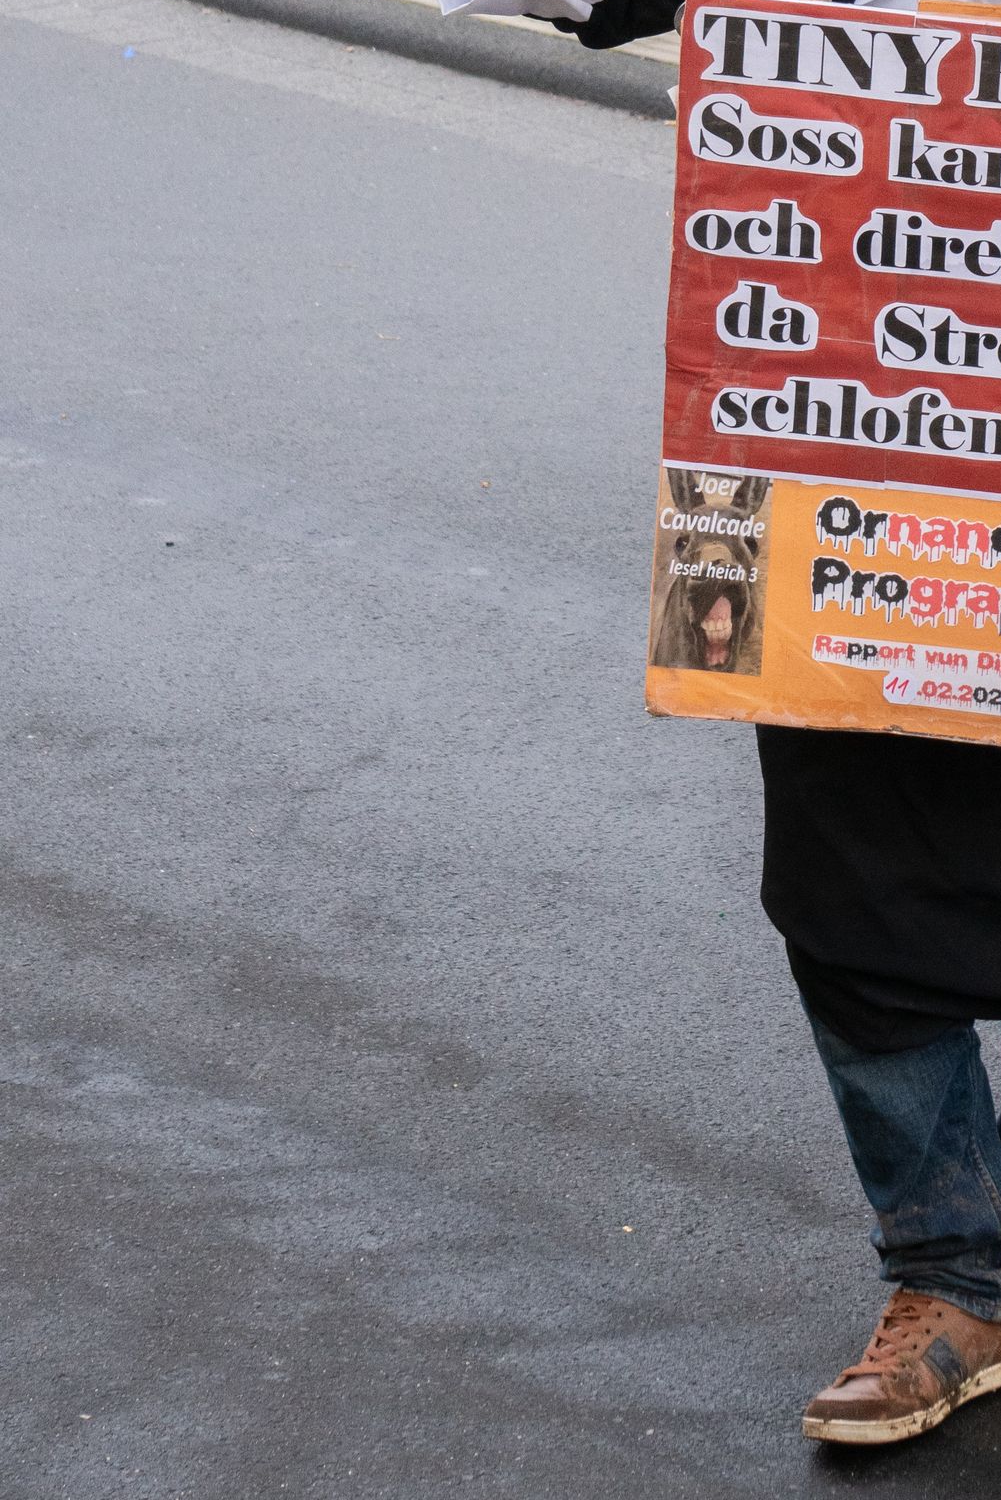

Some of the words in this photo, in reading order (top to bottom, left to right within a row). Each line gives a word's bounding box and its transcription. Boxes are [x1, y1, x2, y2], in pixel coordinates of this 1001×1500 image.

[703, 13, 954, 98] TINY
[698, 99, 858, 169] Soss
[691, 202, 817, 259] och
[722, 284, 811, 346] da
[694, 472, 741, 497] Joer
[659, 507, 766, 539] Cavalcade
[706, 562, 746, 582] heich
[748, 566, 759, 583] 3
[814, 634, 916, 668] Rapport
[924, 650, 969, 675] vun
